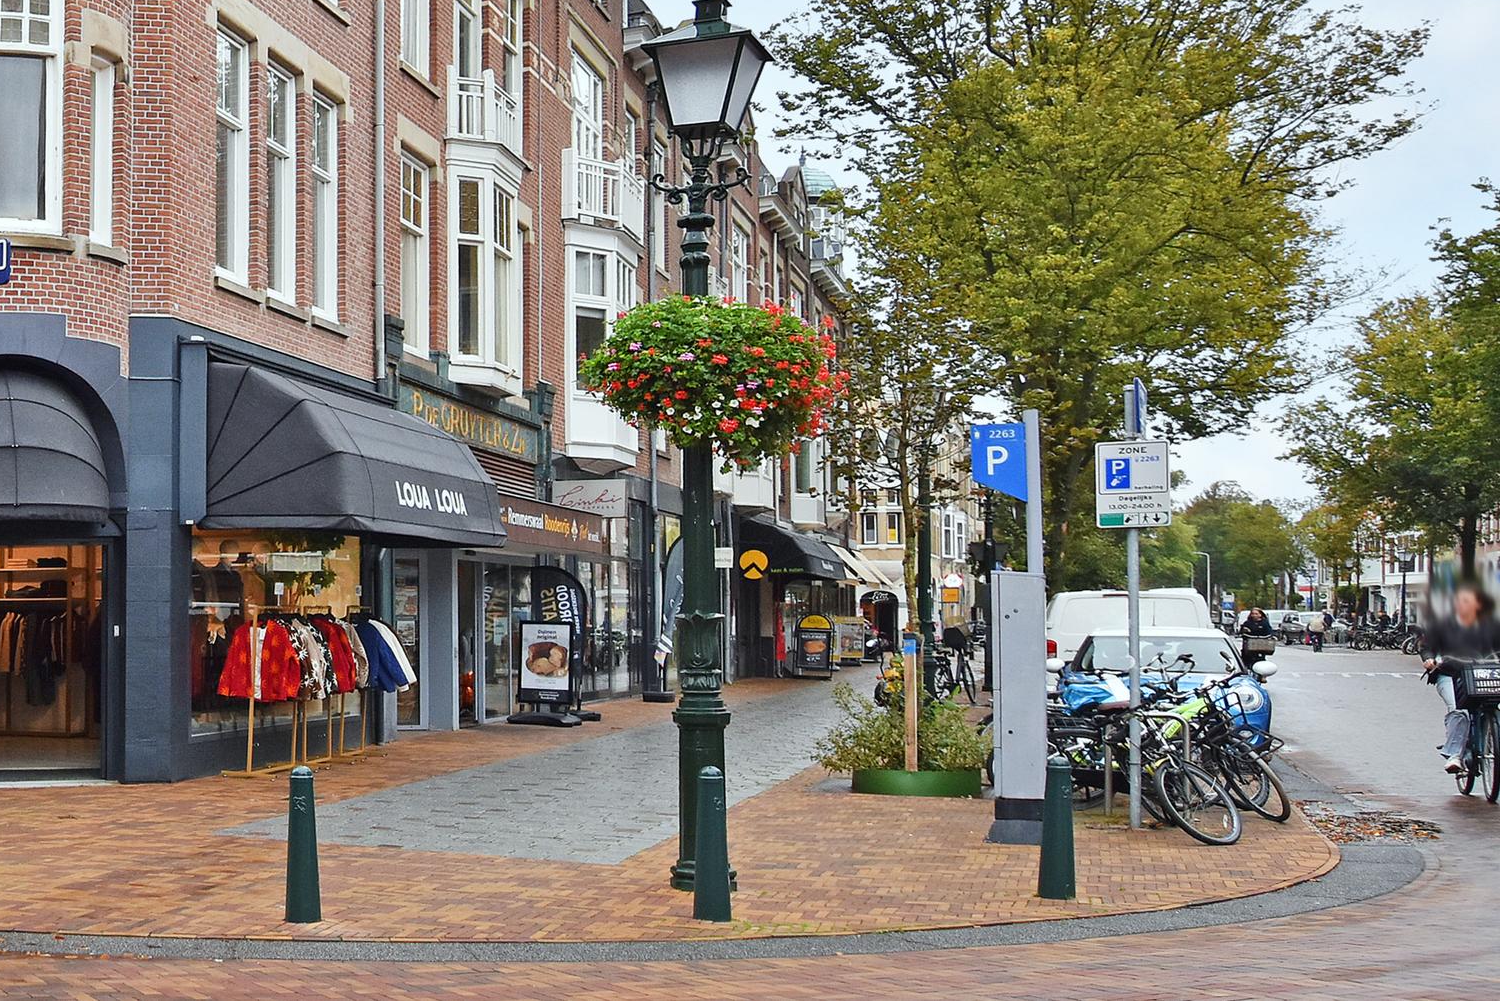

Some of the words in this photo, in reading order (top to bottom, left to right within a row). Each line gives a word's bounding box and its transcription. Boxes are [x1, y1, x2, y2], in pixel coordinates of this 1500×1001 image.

[425, 405, 439, 427] DE
[441, 403, 502, 447] GRUYTER
[989, 429, 1016, 439] 2263
[986, 445, 1009, 476] P
[1118, 446, 1148, 455] ZONE
[1111, 460, 1126, 475] P
[395, 480, 433, 510] LOUA
[434, 488, 469, 517] LOUA
[507, 506, 544, 530] Remmerswaal
